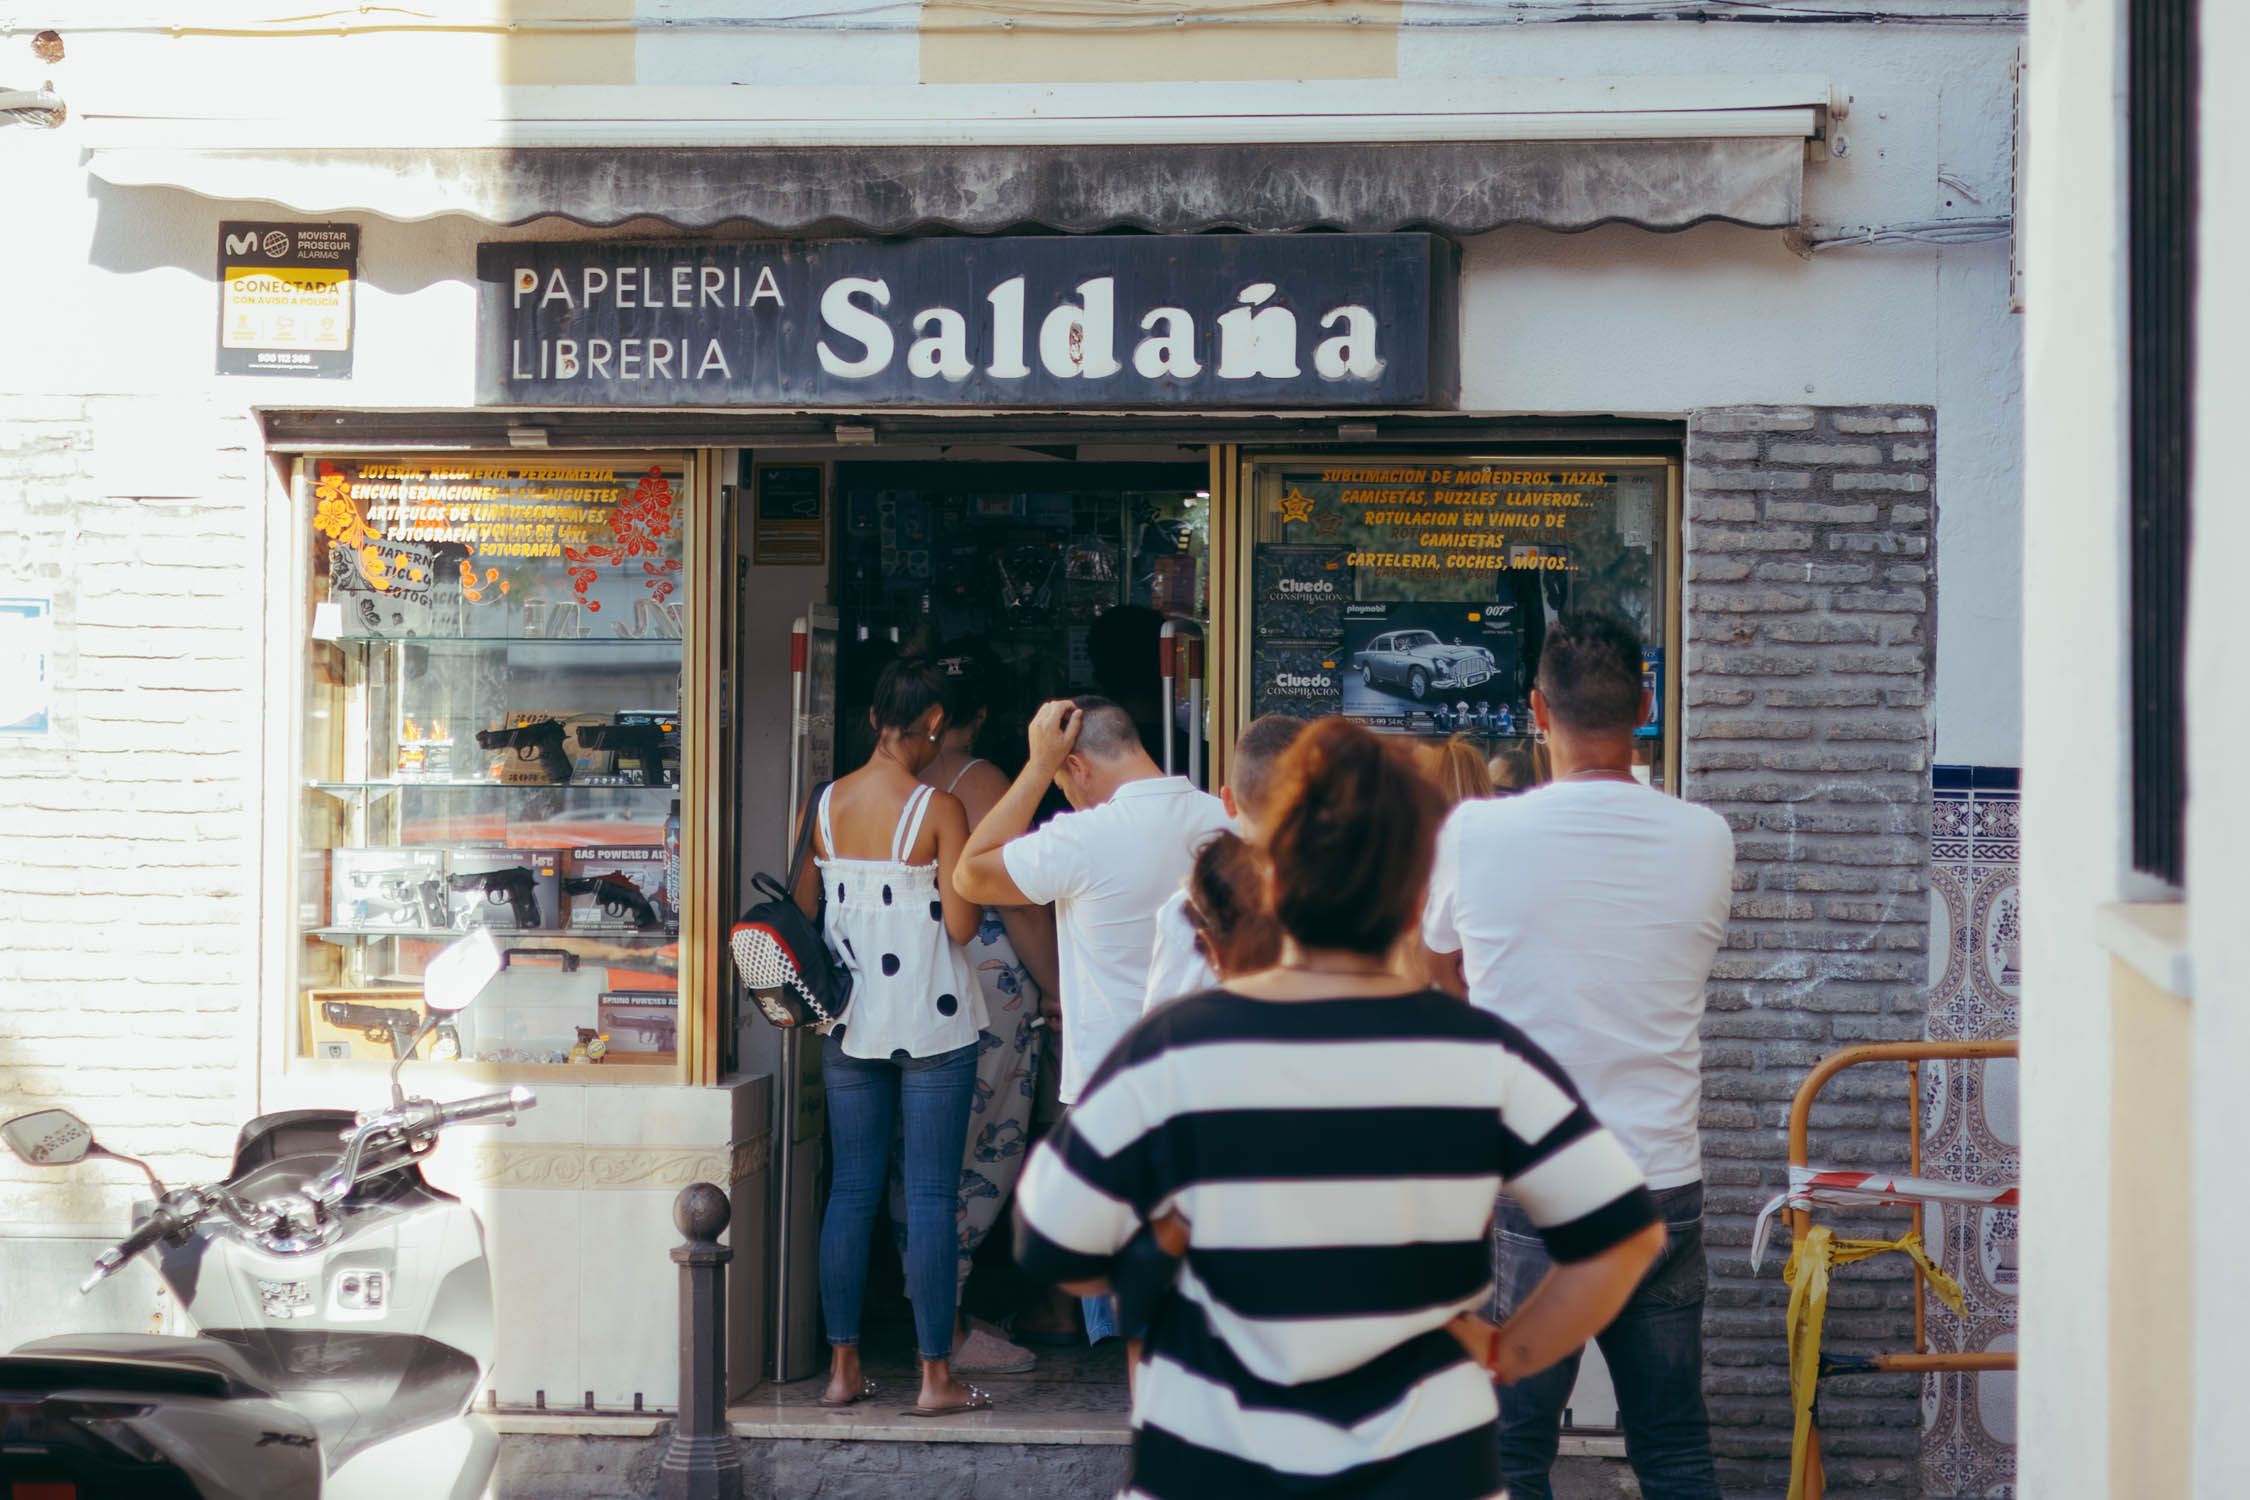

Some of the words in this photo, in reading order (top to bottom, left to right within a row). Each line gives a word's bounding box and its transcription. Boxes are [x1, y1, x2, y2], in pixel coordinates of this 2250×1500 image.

[297, 231, 347, 241] MOVISTAR
[297, 241, 351, 251] PROSEGUR
[297, 251, 340, 260] ALARMAS
[233, 280, 340, 295] CONECTADA
[513, 266, 785, 309] PAPELERIA
[232, 296, 256, 305] CON
[257, 296, 289, 305] AVISO
[290, 297, 298, 305] A
[512, 338, 732, 380] LIBRERIA
[1322, 469, 1426, 483] SUBLIMACION
[1431, 471, 1451, 484] DE
[1560, 472, 1609, 487] TAZAS,
[1340, 490, 1429, 507] CAMISETAS,
[1433, 491, 1498, 505] PUZZLES
[1364, 511, 1460, 527] ROTULACION
[1463, 512, 1485, 527] EN
[1489, 513, 1541, 528] VINILO
[1544, 514, 1567, 529] DE
[1419, 532, 1505, 548] CAMISETAS
[1346, 552, 1441, 570] CARTELERIA,
[1446, 554, 1508, 571] COCHES,
[1511, 556, 1580, 571] MOTOS...
[1279, 578, 1334, 593] Cluedo
[1346, 604, 1387, 615] playmobil
[1485, 605, 1514, 617] 007
[1276, 672, 1332, 688] Cluedo
[574, 849, 596, 860] GAS
[597, 850, 649, 861] POWERED
